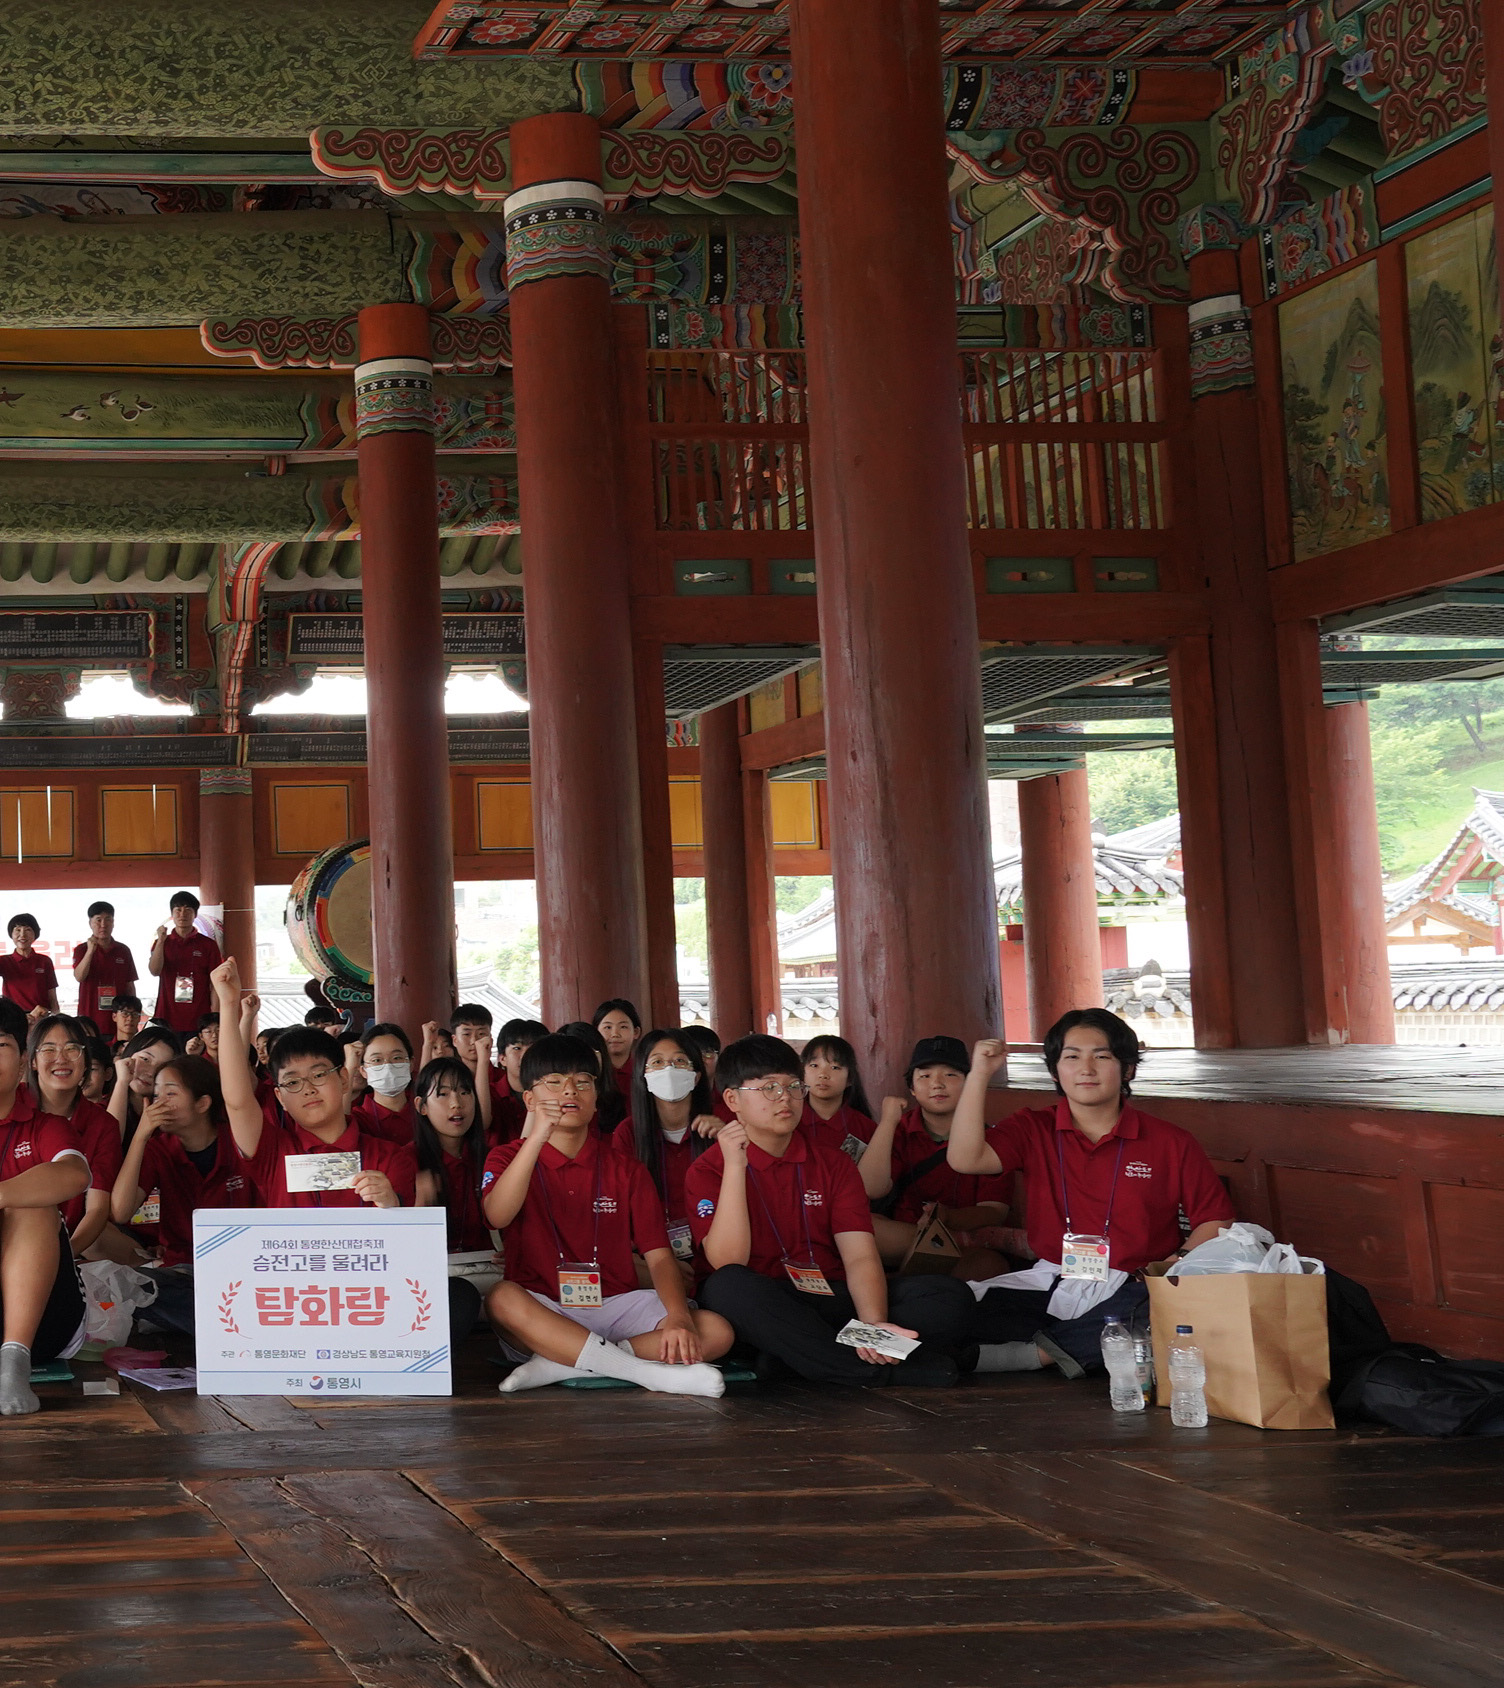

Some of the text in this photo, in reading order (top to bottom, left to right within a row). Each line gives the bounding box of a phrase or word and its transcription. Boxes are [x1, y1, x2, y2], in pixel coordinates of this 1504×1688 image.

[261, 1239, 385, 1250] 제64회 통영한산대첩축제
[252, 1254, 390, 1273] 승전고를 울려라
[254, 1284, 391, 1327] 탐화랑
[220, 1349, 431, 1360] 주관 통영문화재단 경상남도 통영교육지원청
[286, 1377, 362, 1390] 주최 통영시
